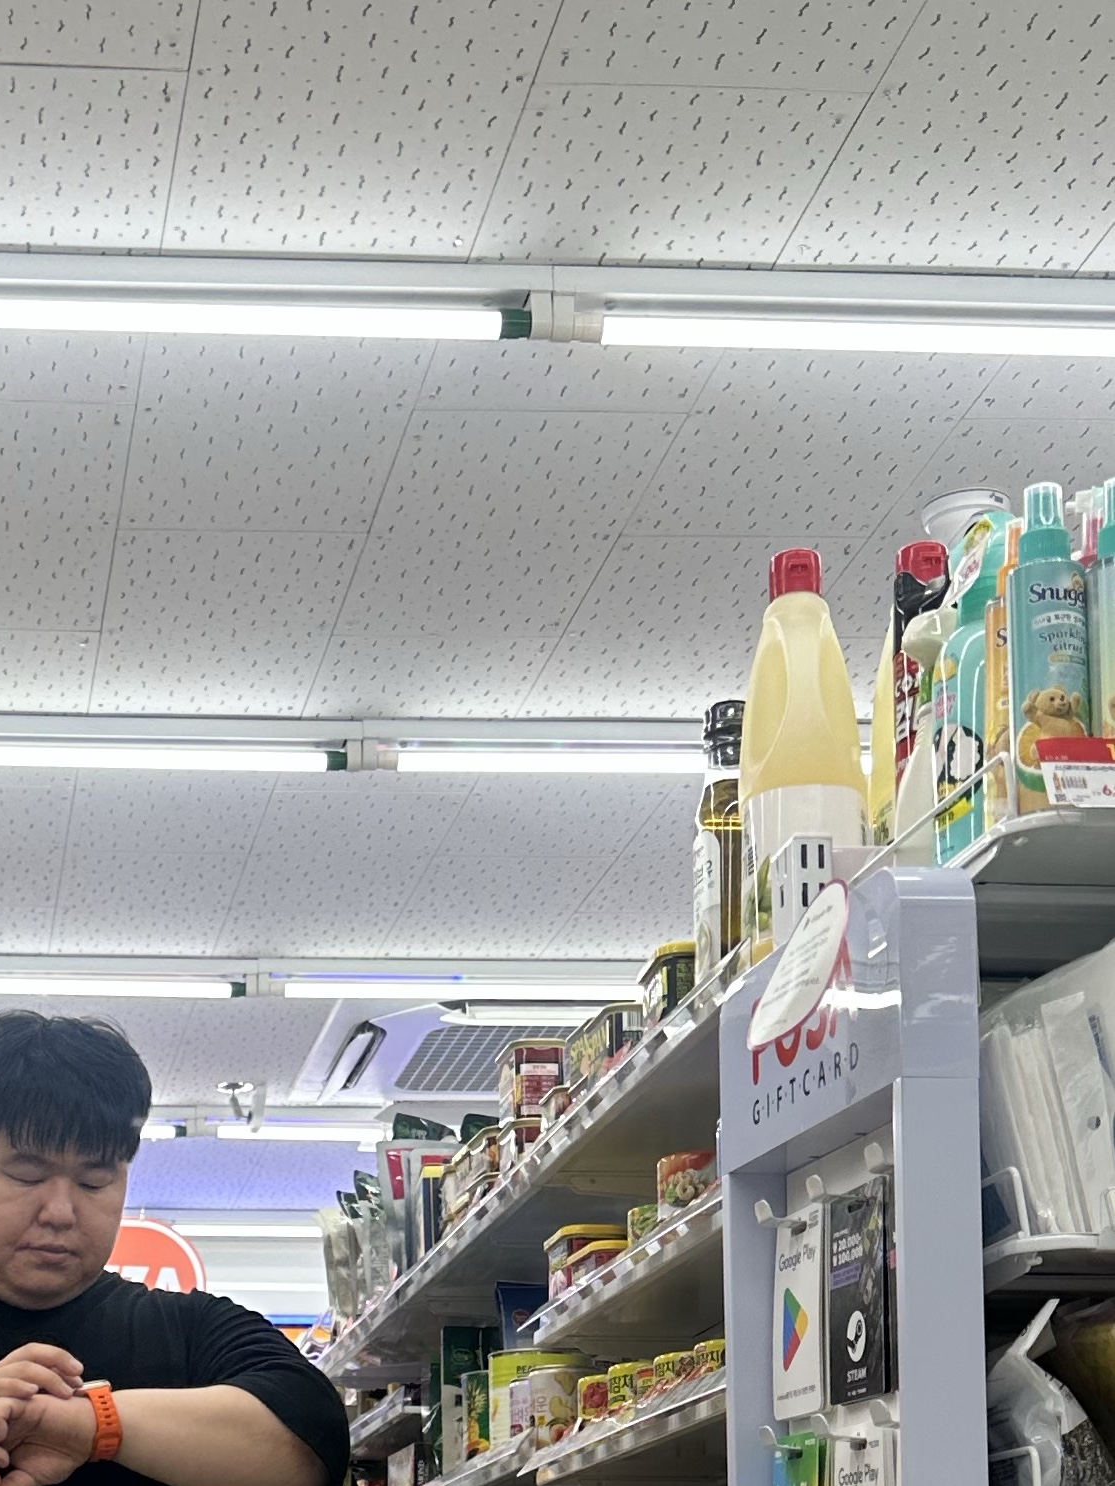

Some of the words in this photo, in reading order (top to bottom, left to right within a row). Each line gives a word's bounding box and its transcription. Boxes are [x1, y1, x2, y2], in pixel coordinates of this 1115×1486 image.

[779, 1252, 802, 1272] Google
[803, 1243, 817, 1262] Play
[847, 1366, 868, 1383] STEAM
[864, 1463, 879, 1486] Play
